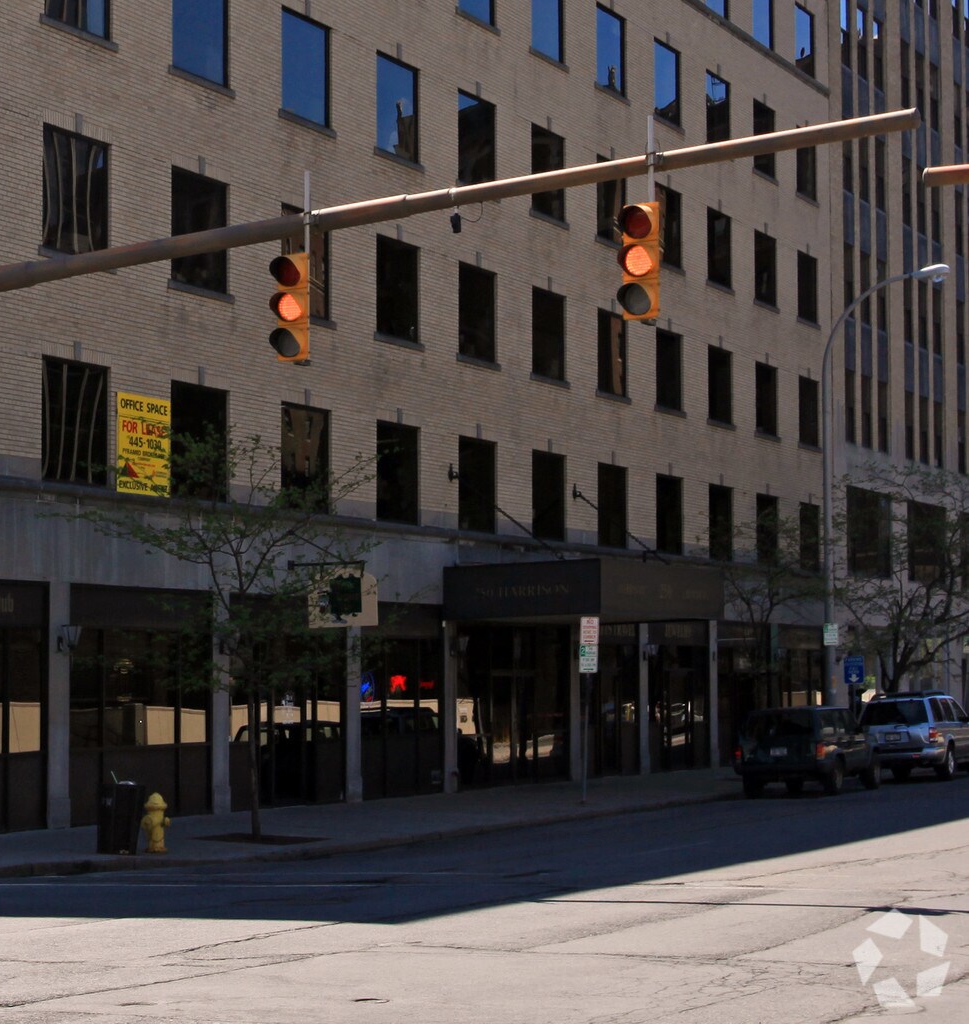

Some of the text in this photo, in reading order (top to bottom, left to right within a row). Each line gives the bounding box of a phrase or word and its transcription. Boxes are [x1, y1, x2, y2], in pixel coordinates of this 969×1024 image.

[120, 398, 168, 416] OFFICE SPACE
[122, 420, 138, 434] FOR
[497, 583, 571, 599] HARRISON
